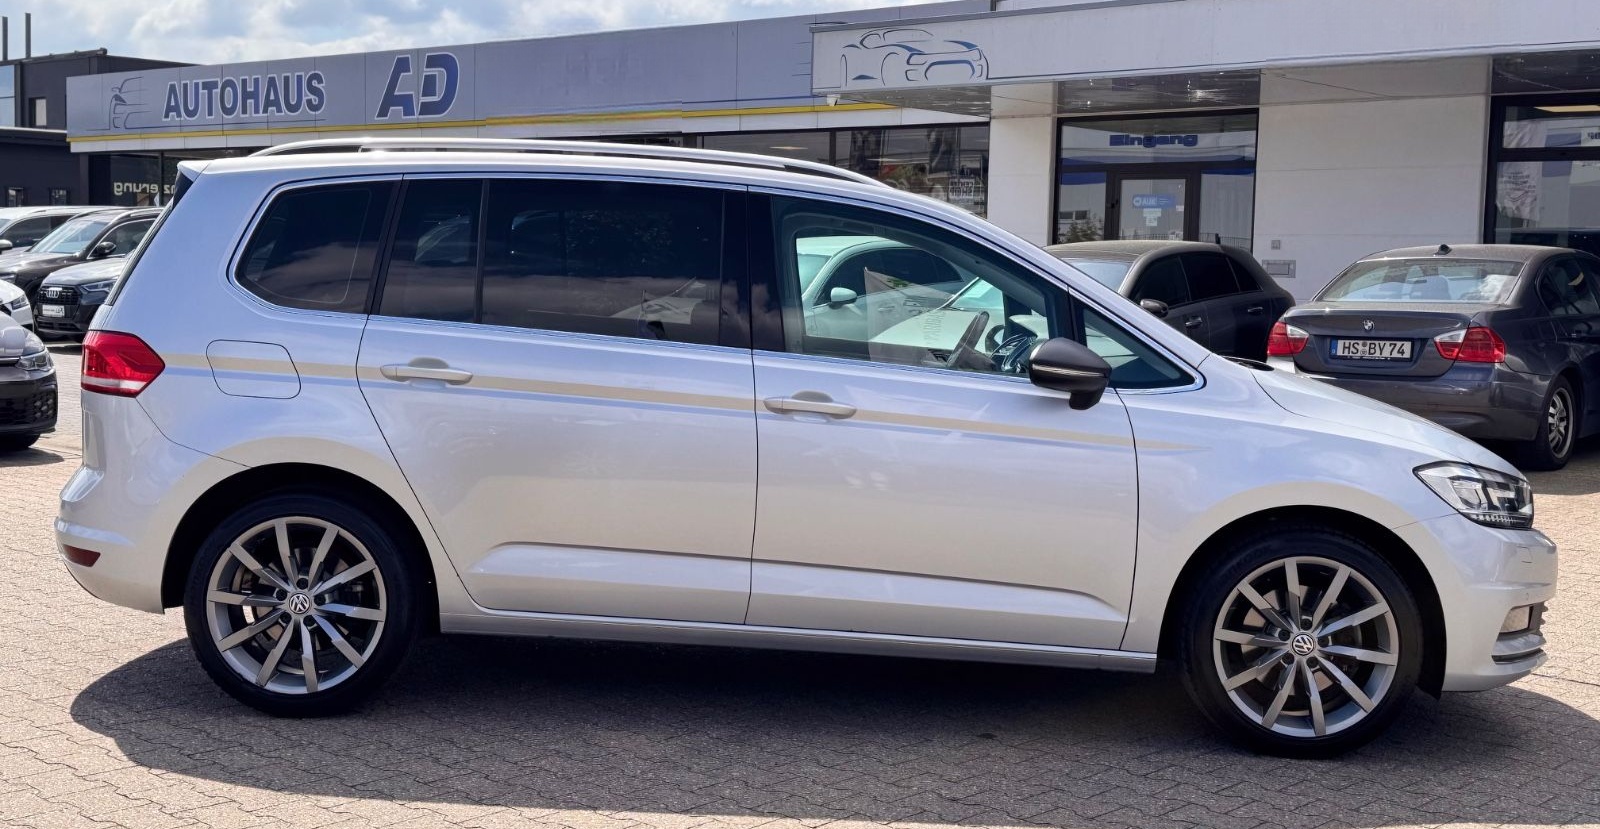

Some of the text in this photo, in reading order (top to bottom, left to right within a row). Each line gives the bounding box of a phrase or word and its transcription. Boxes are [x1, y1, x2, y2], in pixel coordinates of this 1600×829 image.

[163, 52, 460, 120] AUTOHAUS AD
[1109, 134, 1198, 148] Eingang
[1342, 342, 1405, 357] HS BY 74
